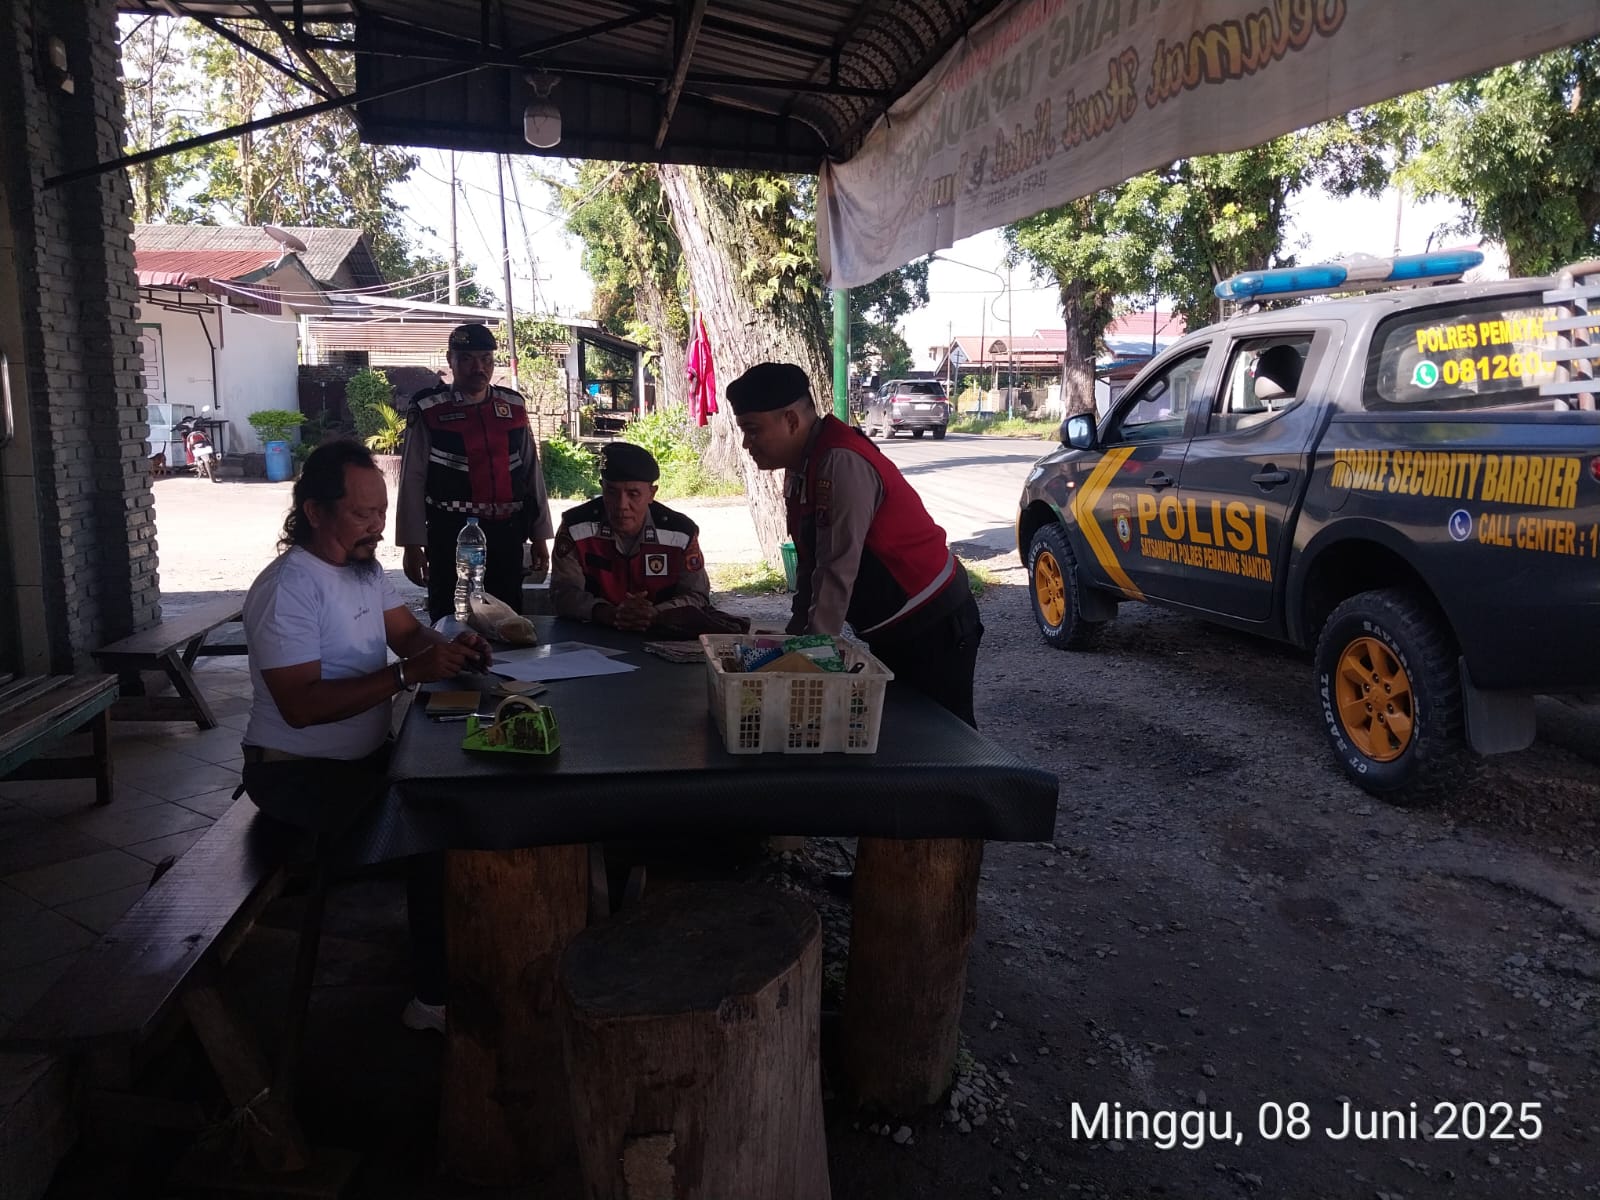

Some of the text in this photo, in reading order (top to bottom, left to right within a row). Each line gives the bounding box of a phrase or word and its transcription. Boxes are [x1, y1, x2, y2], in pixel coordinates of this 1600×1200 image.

[1416, 323, 1478, 353] POLRES
[1331, 448, 1581, 508] MOBILE SECURITY BARRIER
[1137, 493, 1268, 555] POLISI
[1478, 513, 1512, 547] CALL
[1517, 517, 1576, 555] CENTER
[1178, 543, 1203, 568] POLRES
[1204, 547, 1240, 575] PEMATANG
[1241, 553, 1273, 583] SIANTAR
[1321, 673, 1368, 774] GT RADIAL
